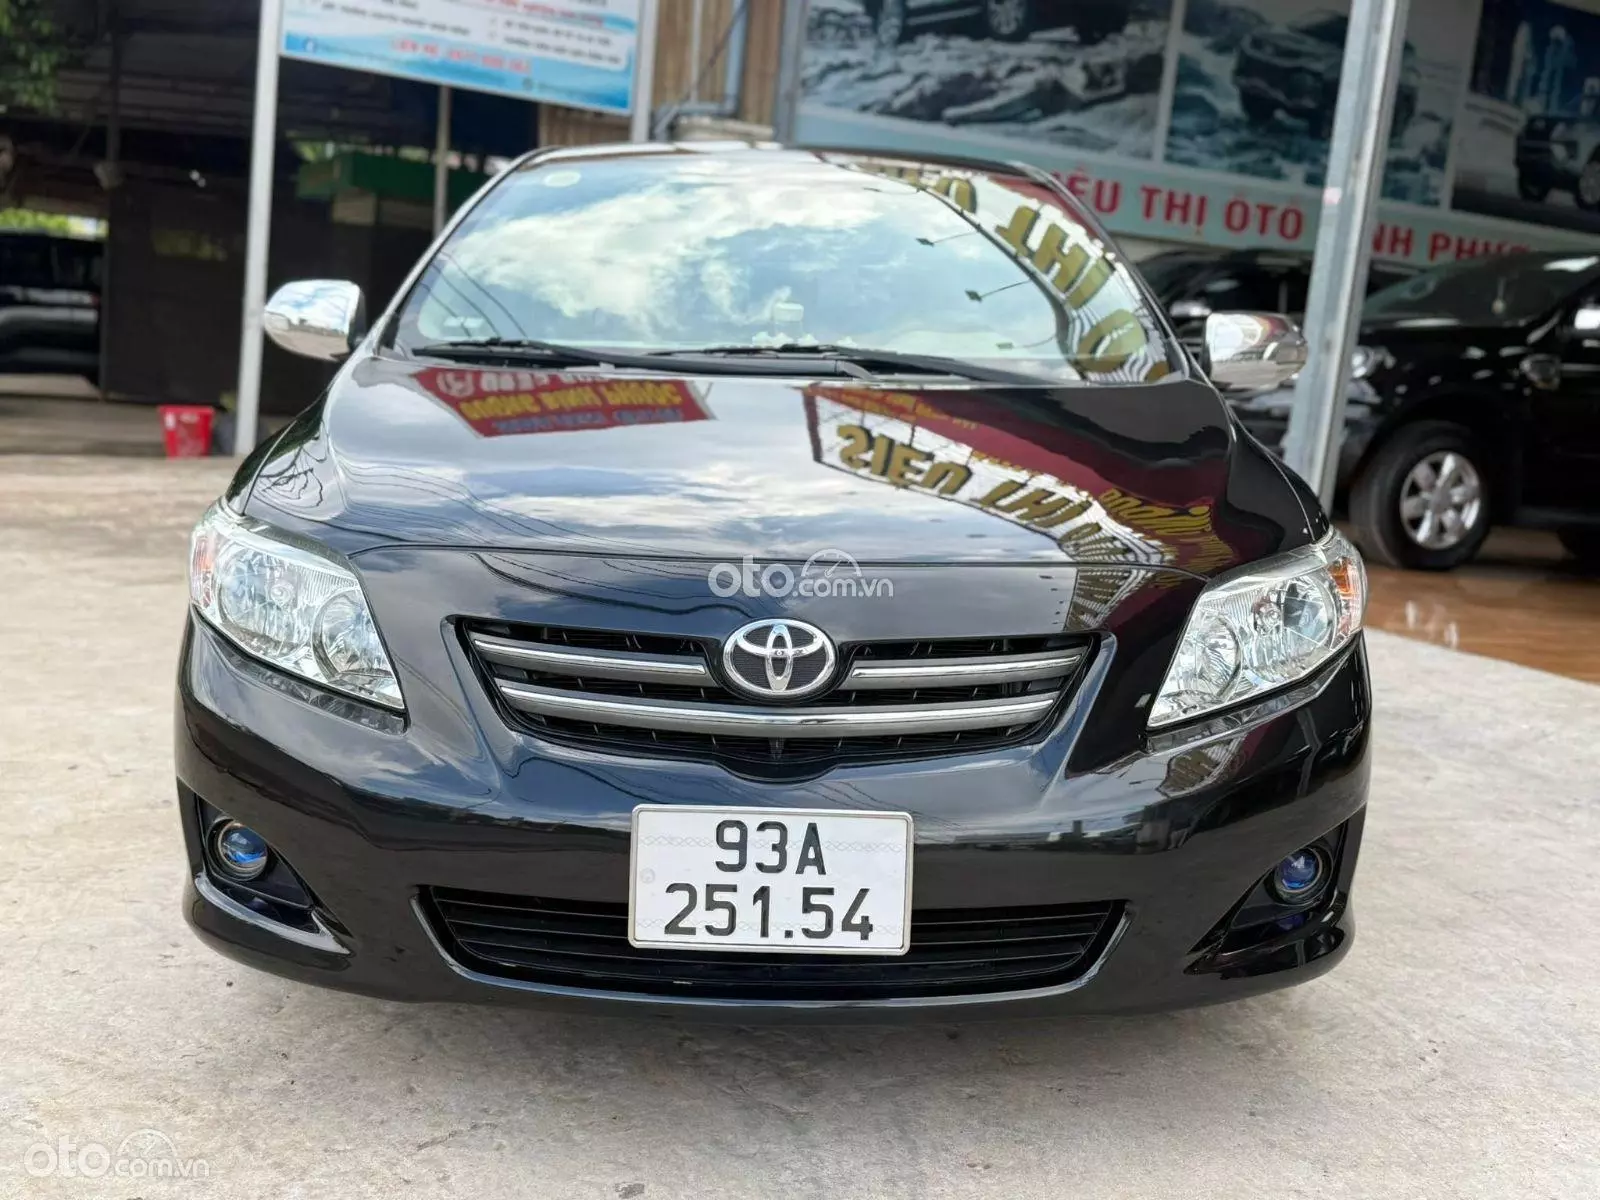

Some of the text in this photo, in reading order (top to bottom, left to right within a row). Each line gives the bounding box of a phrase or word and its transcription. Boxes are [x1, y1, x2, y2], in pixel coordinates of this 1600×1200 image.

[1139, 184, 1208, 238] THỊ
[715, 819, 827, 875] 93A
[664, 882, 874, 941] 251.54
